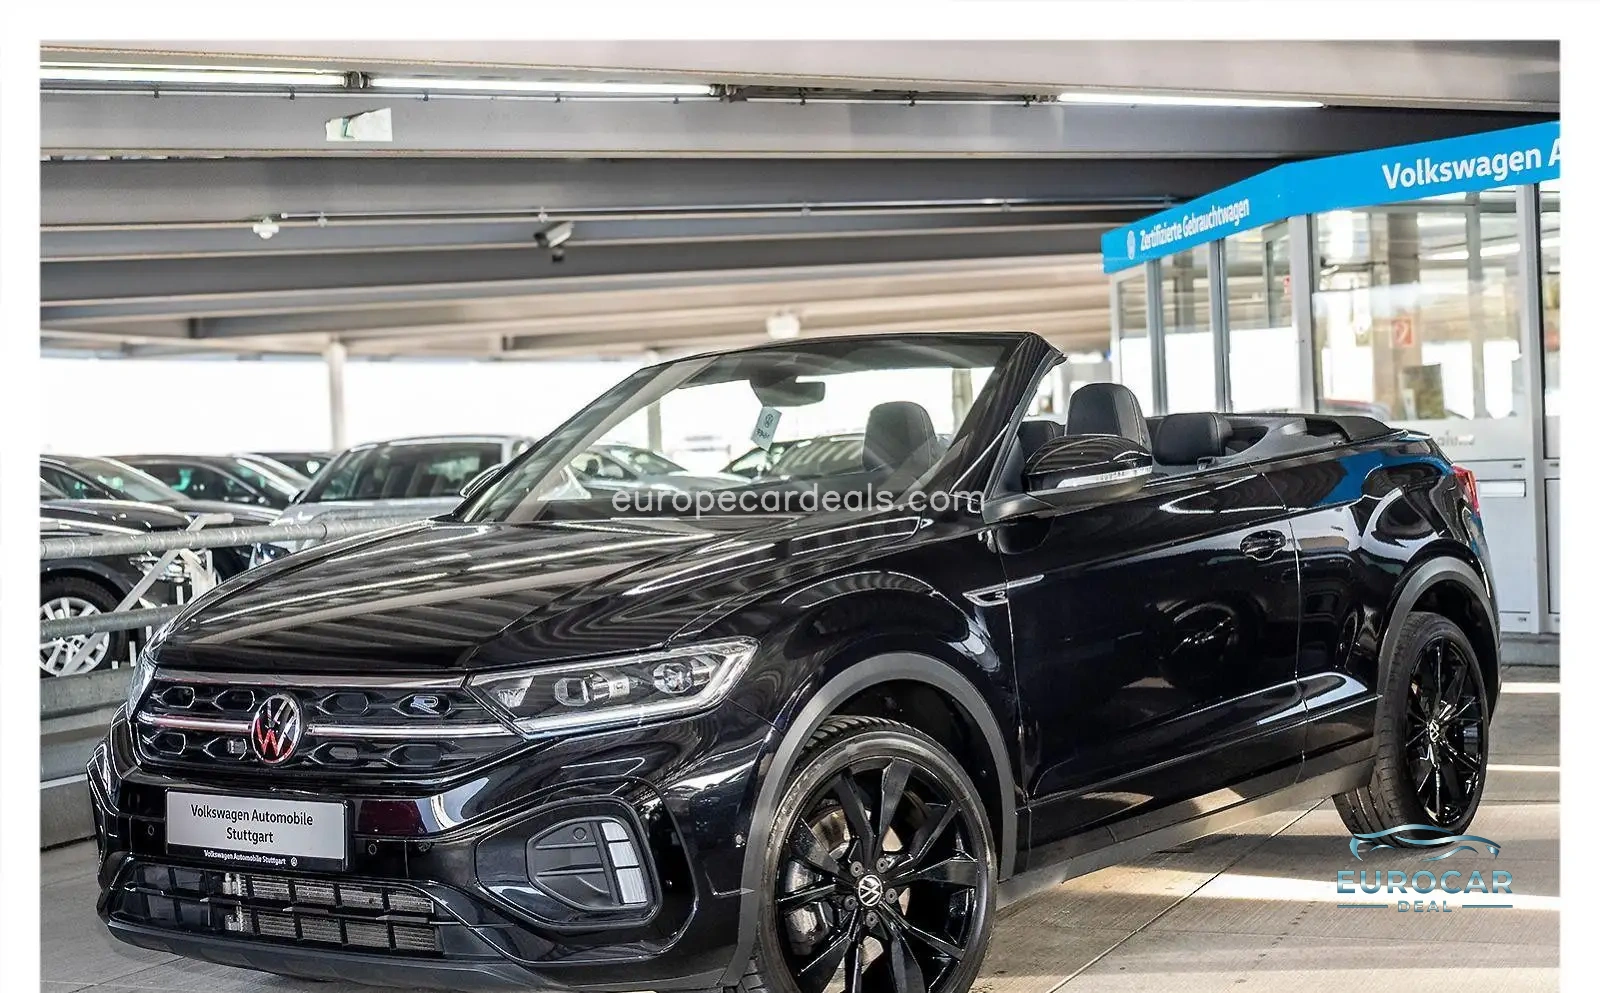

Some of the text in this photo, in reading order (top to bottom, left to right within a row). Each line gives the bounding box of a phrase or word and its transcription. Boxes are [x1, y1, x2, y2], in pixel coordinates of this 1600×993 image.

[1382, 147, 1541, 190] Volkswagen
[1140, 198, 1250, 251] Zertifizierte Gebrauchtwagen
[190, 804, 314, 826] Volkswagen Automobile
[226, 827, 274, 845] Stuttgart
[203, 849, 287, 866] Volkswagen Automobile Stuttgart
